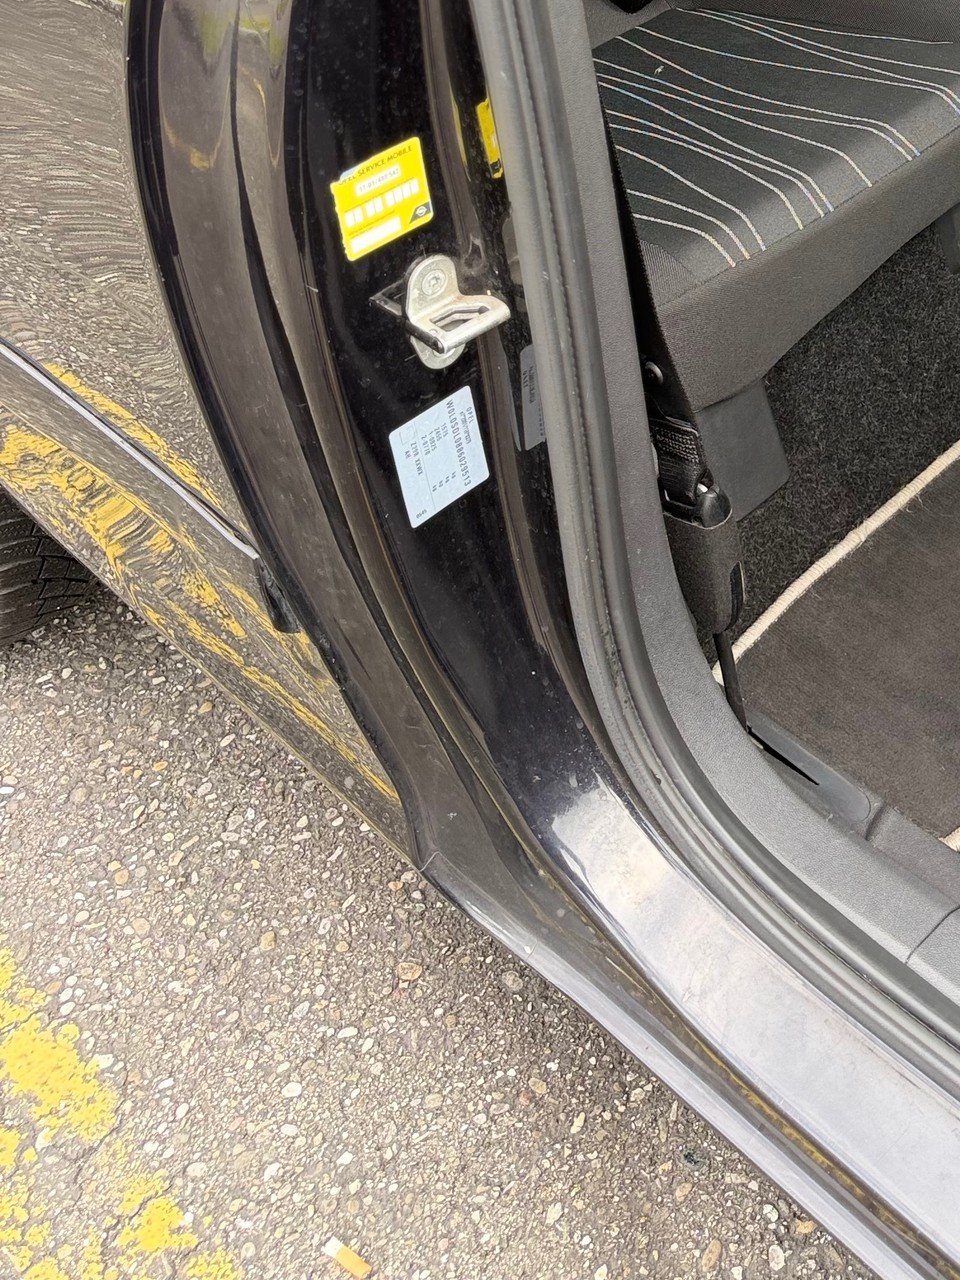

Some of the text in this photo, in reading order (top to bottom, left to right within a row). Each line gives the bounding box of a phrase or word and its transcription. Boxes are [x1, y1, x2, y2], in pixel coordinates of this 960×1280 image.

[357, 158, 385, 176] SERVICE
[387, 145, 413, 162] MOBILE
[466, 406, 475, 424] OPEL
